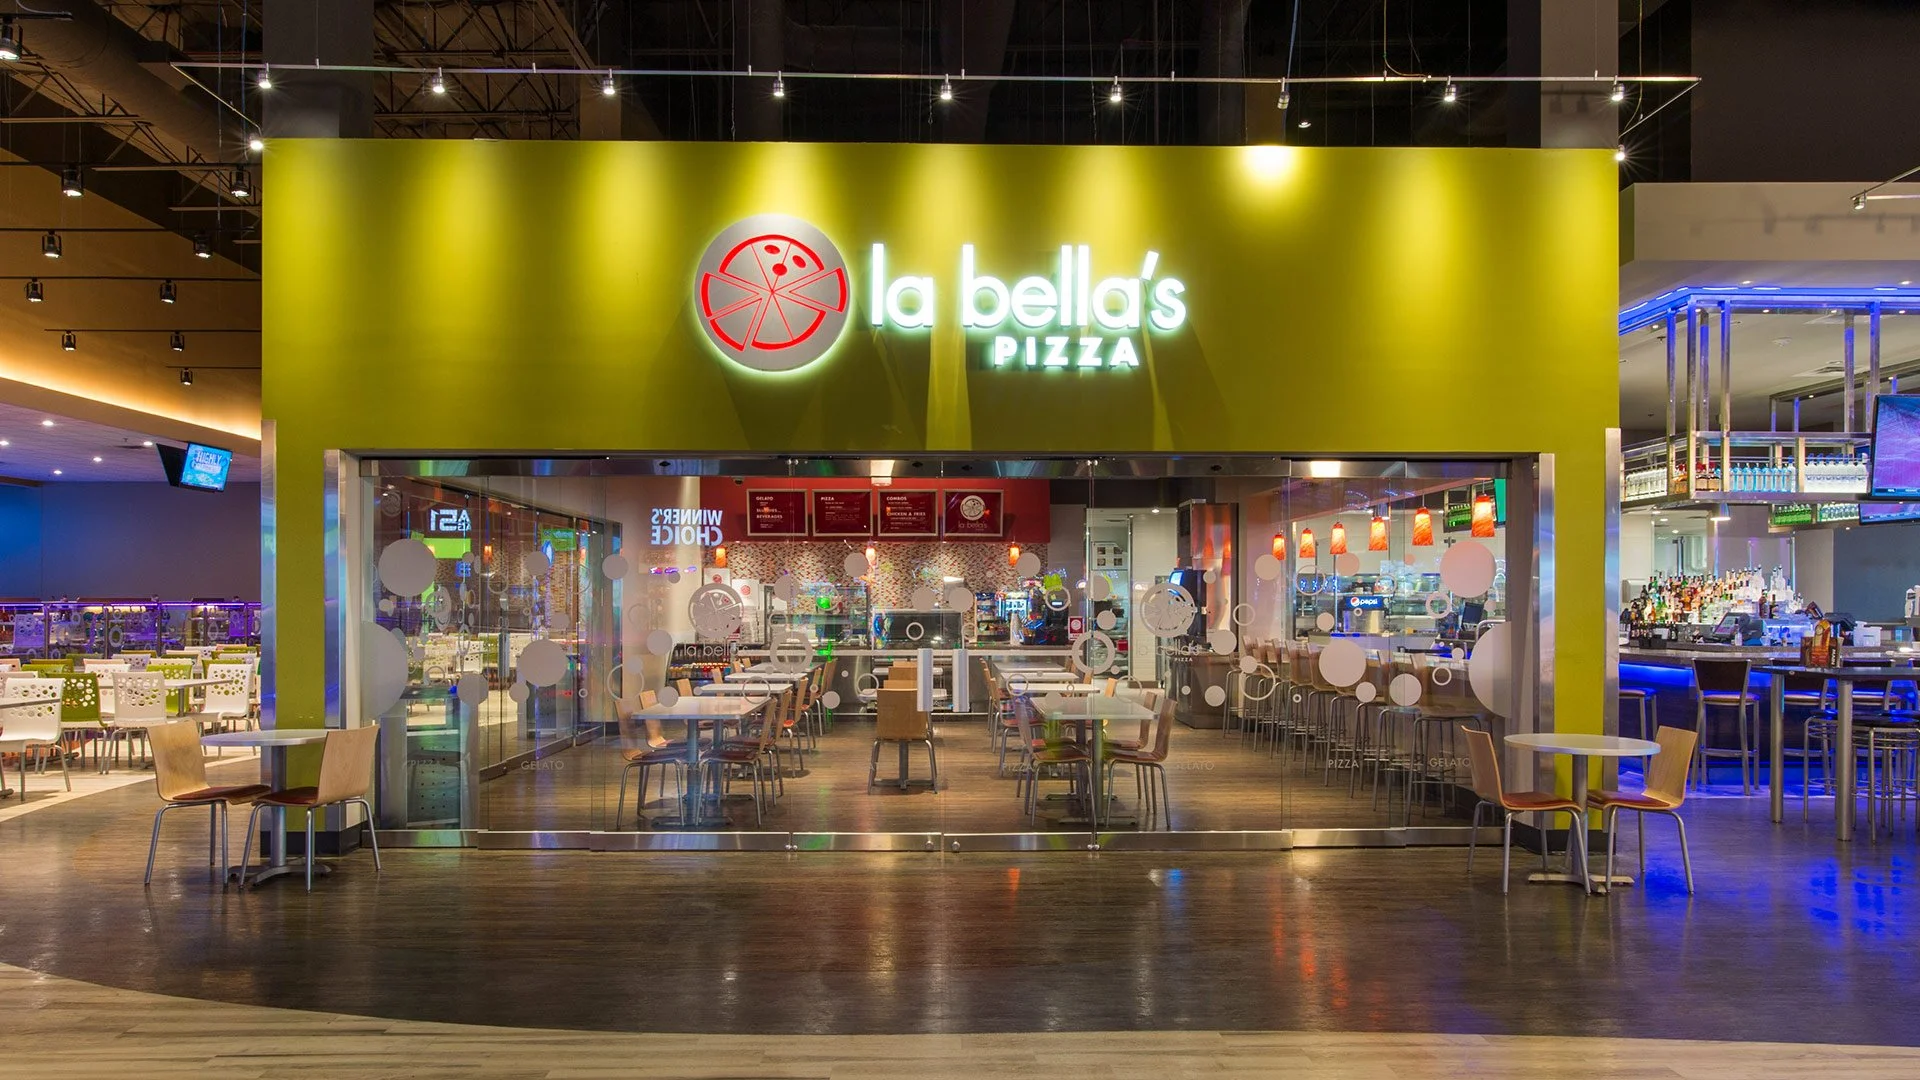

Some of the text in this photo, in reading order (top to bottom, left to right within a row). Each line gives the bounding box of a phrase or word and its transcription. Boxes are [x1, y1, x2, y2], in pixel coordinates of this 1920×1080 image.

[871, 243, 1187, 330] la bella's
[993, 336, 1140, 368] PIZZA
[1360, 598, 1378, 606] pepsi
[683, 640, 698, 656] la
[520, 760, 565, 770] GELATO
[1328, 759, 1360, 769] PIZZA
[1429, 758, 1472, 768] GELATO
